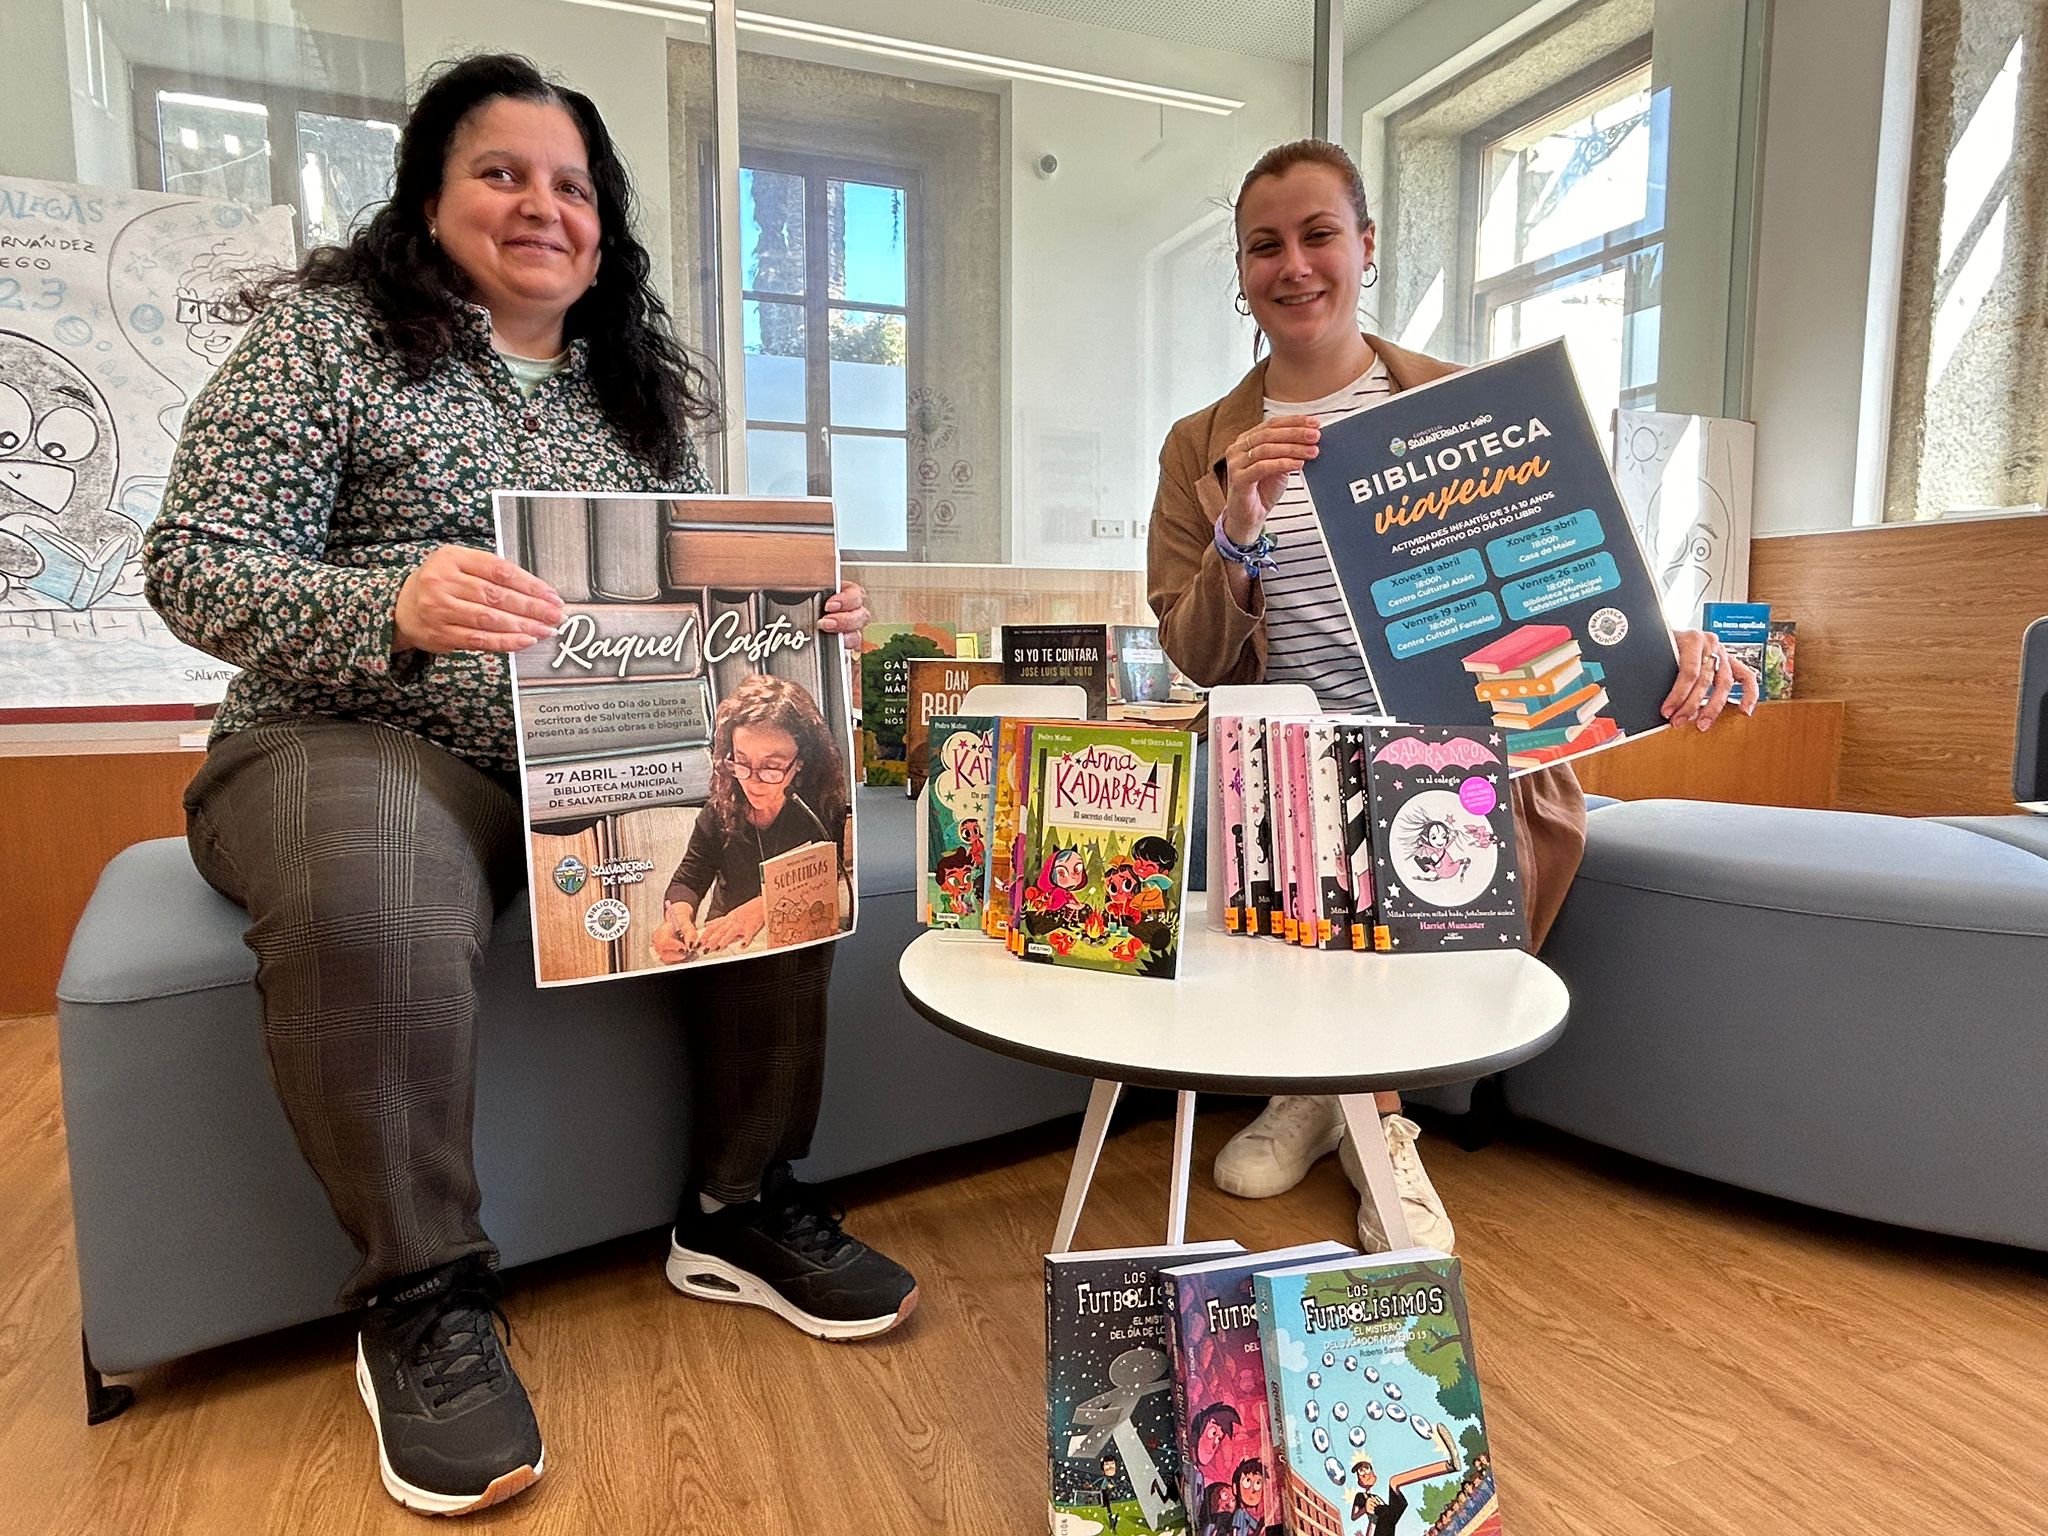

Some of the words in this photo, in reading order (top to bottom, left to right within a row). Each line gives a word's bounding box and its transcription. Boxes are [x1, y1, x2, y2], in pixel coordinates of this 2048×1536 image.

[1407, 425, 1460, 450] SALVATERRA
[1458, 421, 1471, 432] DE
[1349, 417, 1552, 504] BIBLIOTECA
[1375, 455, 1551, 535] viaxeira
[1391, 527, 1449, 554] ACTIVIDADES
[1449, 512, 1489, 533] INFANTÍS
[1490, 509, 1504, 519] DE
[1503, 506, 1511, 515] 3
[1510, 504, 1518, 512] A
[1518, 500, 1528, 509] 10
[1529, 490, 1555, 506] ANOS
[1410, 545, 1430, 557] CON
[1431, 531, 1466, 551] MOTIVO
[1466, 527, 1481, 538] DO
[1483, 519, 1500, 533] DÍA
[1500, 514, 1515, 525] DO
[1515, 506, 1542, 520] LIBRO
[1506, 532, 1537, 547] Xoves
[1540, 526, 1553, 536] 25
[1554, 516, 1578, 531] abril
[1519, 552, 1540, 563] Casa
[1541, 546, 1552, 555] do
[1553, 538, 1577, 551] Maior
[1391, 573, 1422, 588] Xoves
[1423, 566, 1436, 576] 18
[1437, 557, 1460, 571] abril
[1517, 575, 1555, 591] Venres
[1557, 568, 1570, 578] 26
[1572, 558, 1596, 573] abril
[1388, 594, 1416, 607] Centro
[1417, 581, 1450, 598] Cultural
[1523, 589, 1563, 608] Biblioteca
[1564, 575, 1603, 594] Municipal
[1528, 596, 1569, 612] Salvaterra
[1569, 591, 1580, 600] de
[1580, 585, 1601, 597] Miño
[1402, 612, 1439, 630] Venres
[1440, 607, 1451, 616] 19
[1453, 599, 1477, 613] abril
[1591, 609, 1622, 628] BIBLIOTECA
[1397, 638, 1425, 651] Centro
[1425, 626, 1459, 641] Cultural
[1593, 623, 1627, 643] MUNICIPAL
[552, 614, 695, 677] Raquel
[704, 611, 811, 663] Castro
[1014, 649, 1024, 662] SI
[1027, 649, 1039, 662] YO
[1042, 648, 1053, 662] TE
[1056, 648, 1098, 662] CONTARA
[945, 670, 969, 691] DAN
[1020, 665, 1039, 677] JOSÉ
[1041, 667, 1057, 677] LUIS
[1060, 667, 1071, 676] GIL
[1074, 666, 1093, 676] SOTO
[539, 705, 560, 713] Con
[563, 701, 600, 712] motivo
[603, 701, 615, 710] do
[637, 699, 651, 707] do
[653, 697, 678, 706] Libro
[921, 692, 967, 725] BRO
[535, 714, 582, 726] escritora
[584, 714, 597, 722] de
[600, 711, 651, 721] Salvaterra
[653, 709, 665, 718] de
[527, 729, 575, 740] presenta
[618, 722, 646, 732] obras
[1082, 746, 1137, 772] Anna
[1385, 743, 1444, 765] ISADORA
[1448, 743, 1488, 761] MOON
[546, 772, 564, 784] 27
[569, 768, 617, 782] ABRIL
[630, 763, 667, 776] 12:00
[672, 762, 682, 773] H
[1426, 775, 1433, 784] al
[1434, 775, 1461, 786] colegio
[553, 782, 618, 796] BIBLIOTECA
[620, 777, 679, 790] MUNICIPAL
[1055, 758, 1161, 813] KADABRA
[549, 798, 565, 808] DE
[567, 793, 638, 806] SALVATERRA
[639, 790, 653, 799] DE
[656, 786, 684, 798] MIÑO
[1104, 813, 1113, 822] del
[591, 859, 654, 877] SALVATERRA
[603, 876, 617, 886] DE
[618, 872, 643, 883] MIÑO
[587, 900, 627, 919] BIBLIOTECA
[588, 921, 628, 939] MUNICIPAL
[1420, 921, 1446, 930] Harriet
[1448, 921, 1485, 930] Muncaster
[1124, 1272, 1147, 1284] LOS
[1346, 1284, 1368, 1297] LOS
[1133, 1316, 1143, 1325] EL
[1354, 1327, 1364, 1336] EL
[1365, 1322, 1401, 1334] MISTERIO
[1110, 1330, 1126, 1340] DEL
[1127, 1326, 1142, 1338] DÍA
[1143, 1327, 1154, 1336] DE
[1343, 1335, 1379, 1349] JUGADOR
[1416, 1330, 1427, 1340] 13
[1244, 1342, 1260, 1352] DEL
[1360, 1349, 1383, 1357] Roberto
